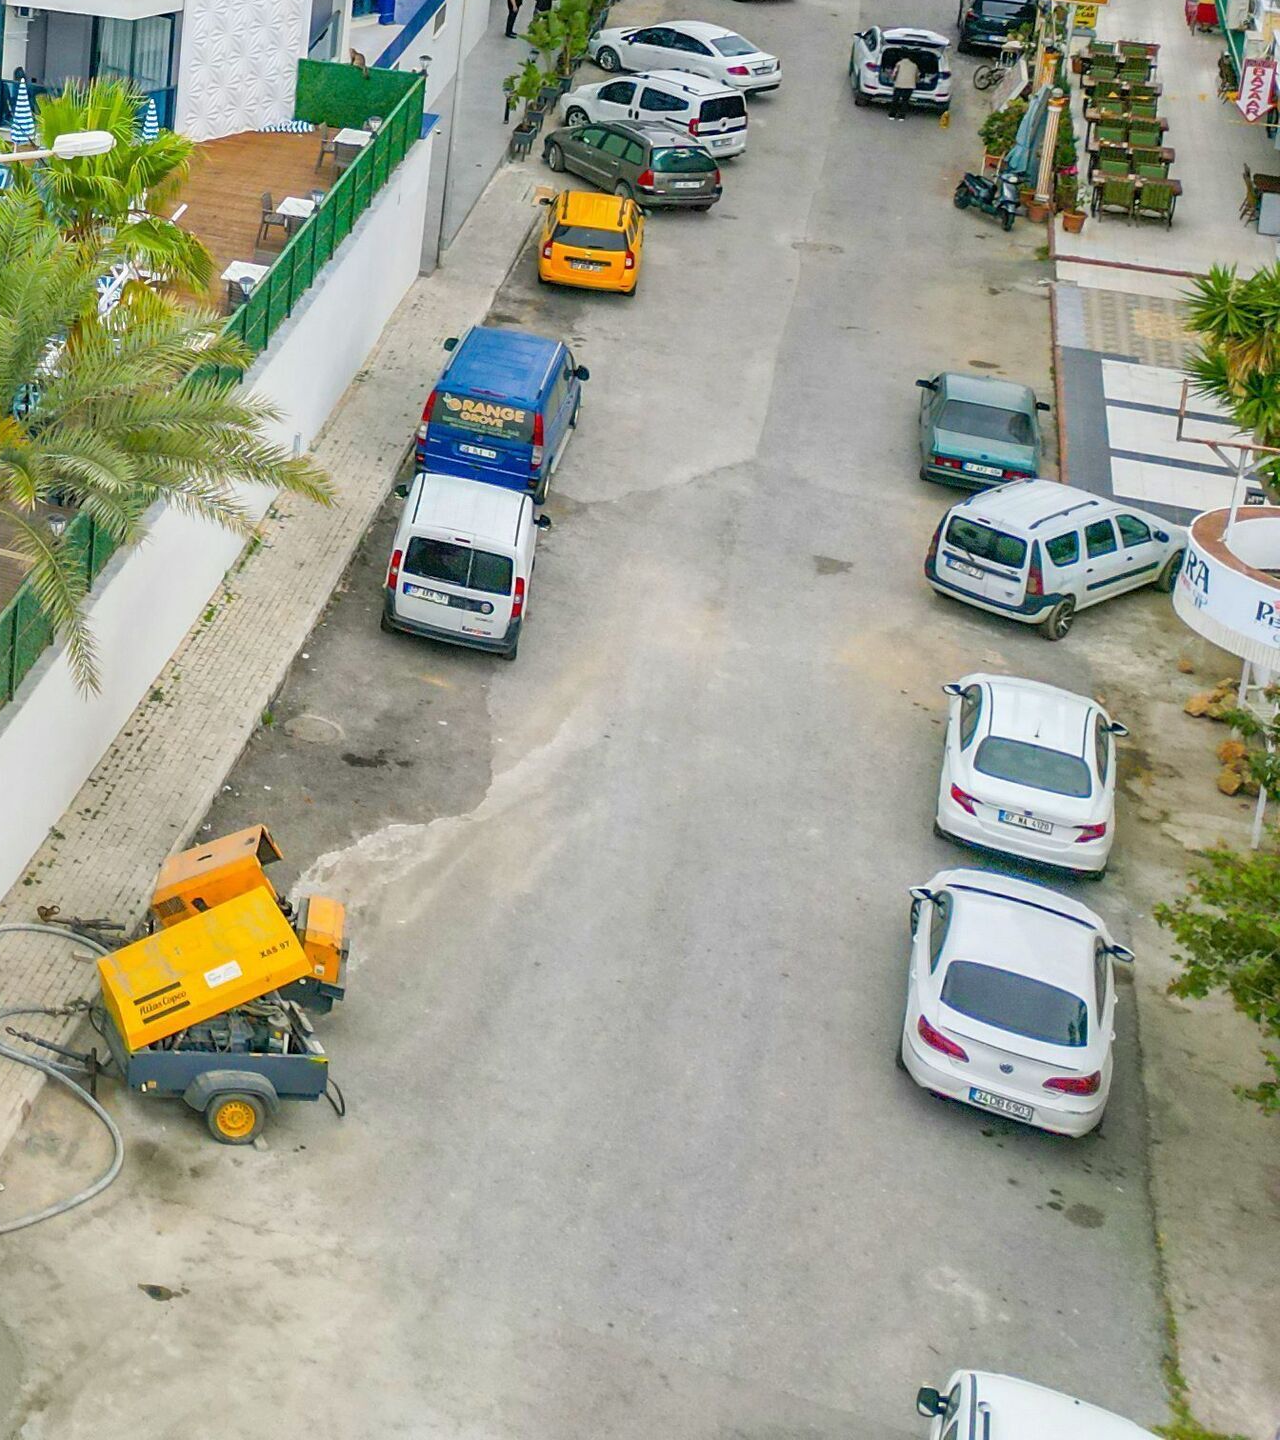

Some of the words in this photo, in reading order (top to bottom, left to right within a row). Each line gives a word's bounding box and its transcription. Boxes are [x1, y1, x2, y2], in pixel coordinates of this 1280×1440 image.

[460, 411, 504, 427] GROVE
[260, 946, 278, 958] XAS
[140, 1001, 162, 1017] Atlas
[162, 990, 187, 1006] Copco
